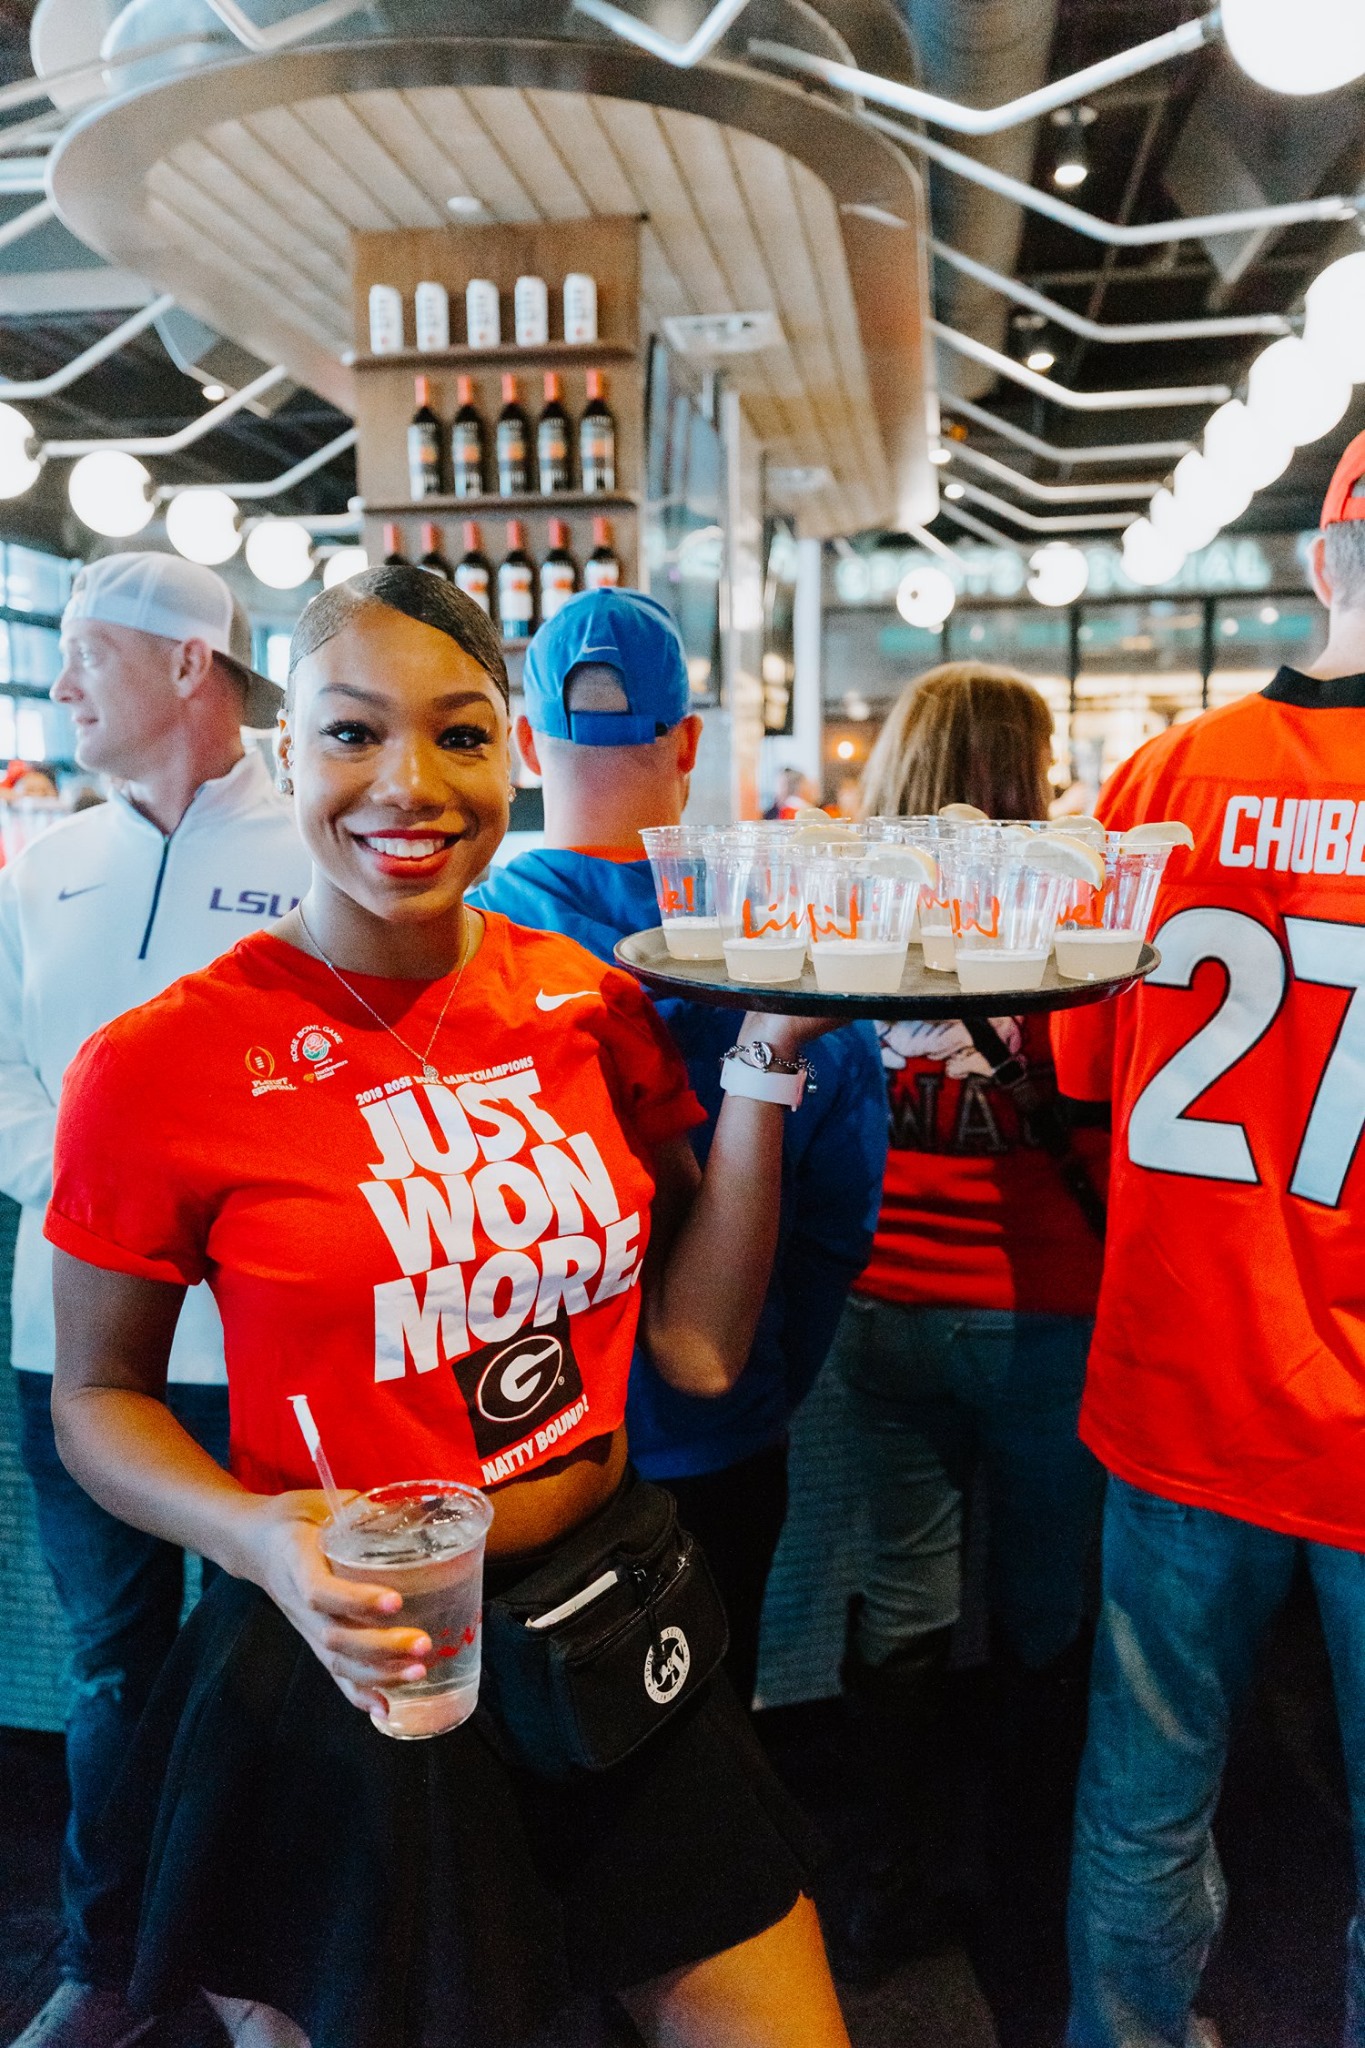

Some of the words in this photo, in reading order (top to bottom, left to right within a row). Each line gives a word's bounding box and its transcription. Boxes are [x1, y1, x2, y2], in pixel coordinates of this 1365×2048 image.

[209, 887, 300, 918] LSU
[355, 1086, 384, 1106] 2018
[384, 1076, 413, 1095] ROSE
[473, 1055, 534, 1082] CHAMPIONS
[1128, 905, 1365, 1209] 27
[359, 1069, 567, 1180] JUST
[357, 1131, 621, 1276] WON
[499, 1339, 561, 1404] G
[480, 1438, 534, 1485] NATTY
[534, 1393, 590, 1453] BOUND!
